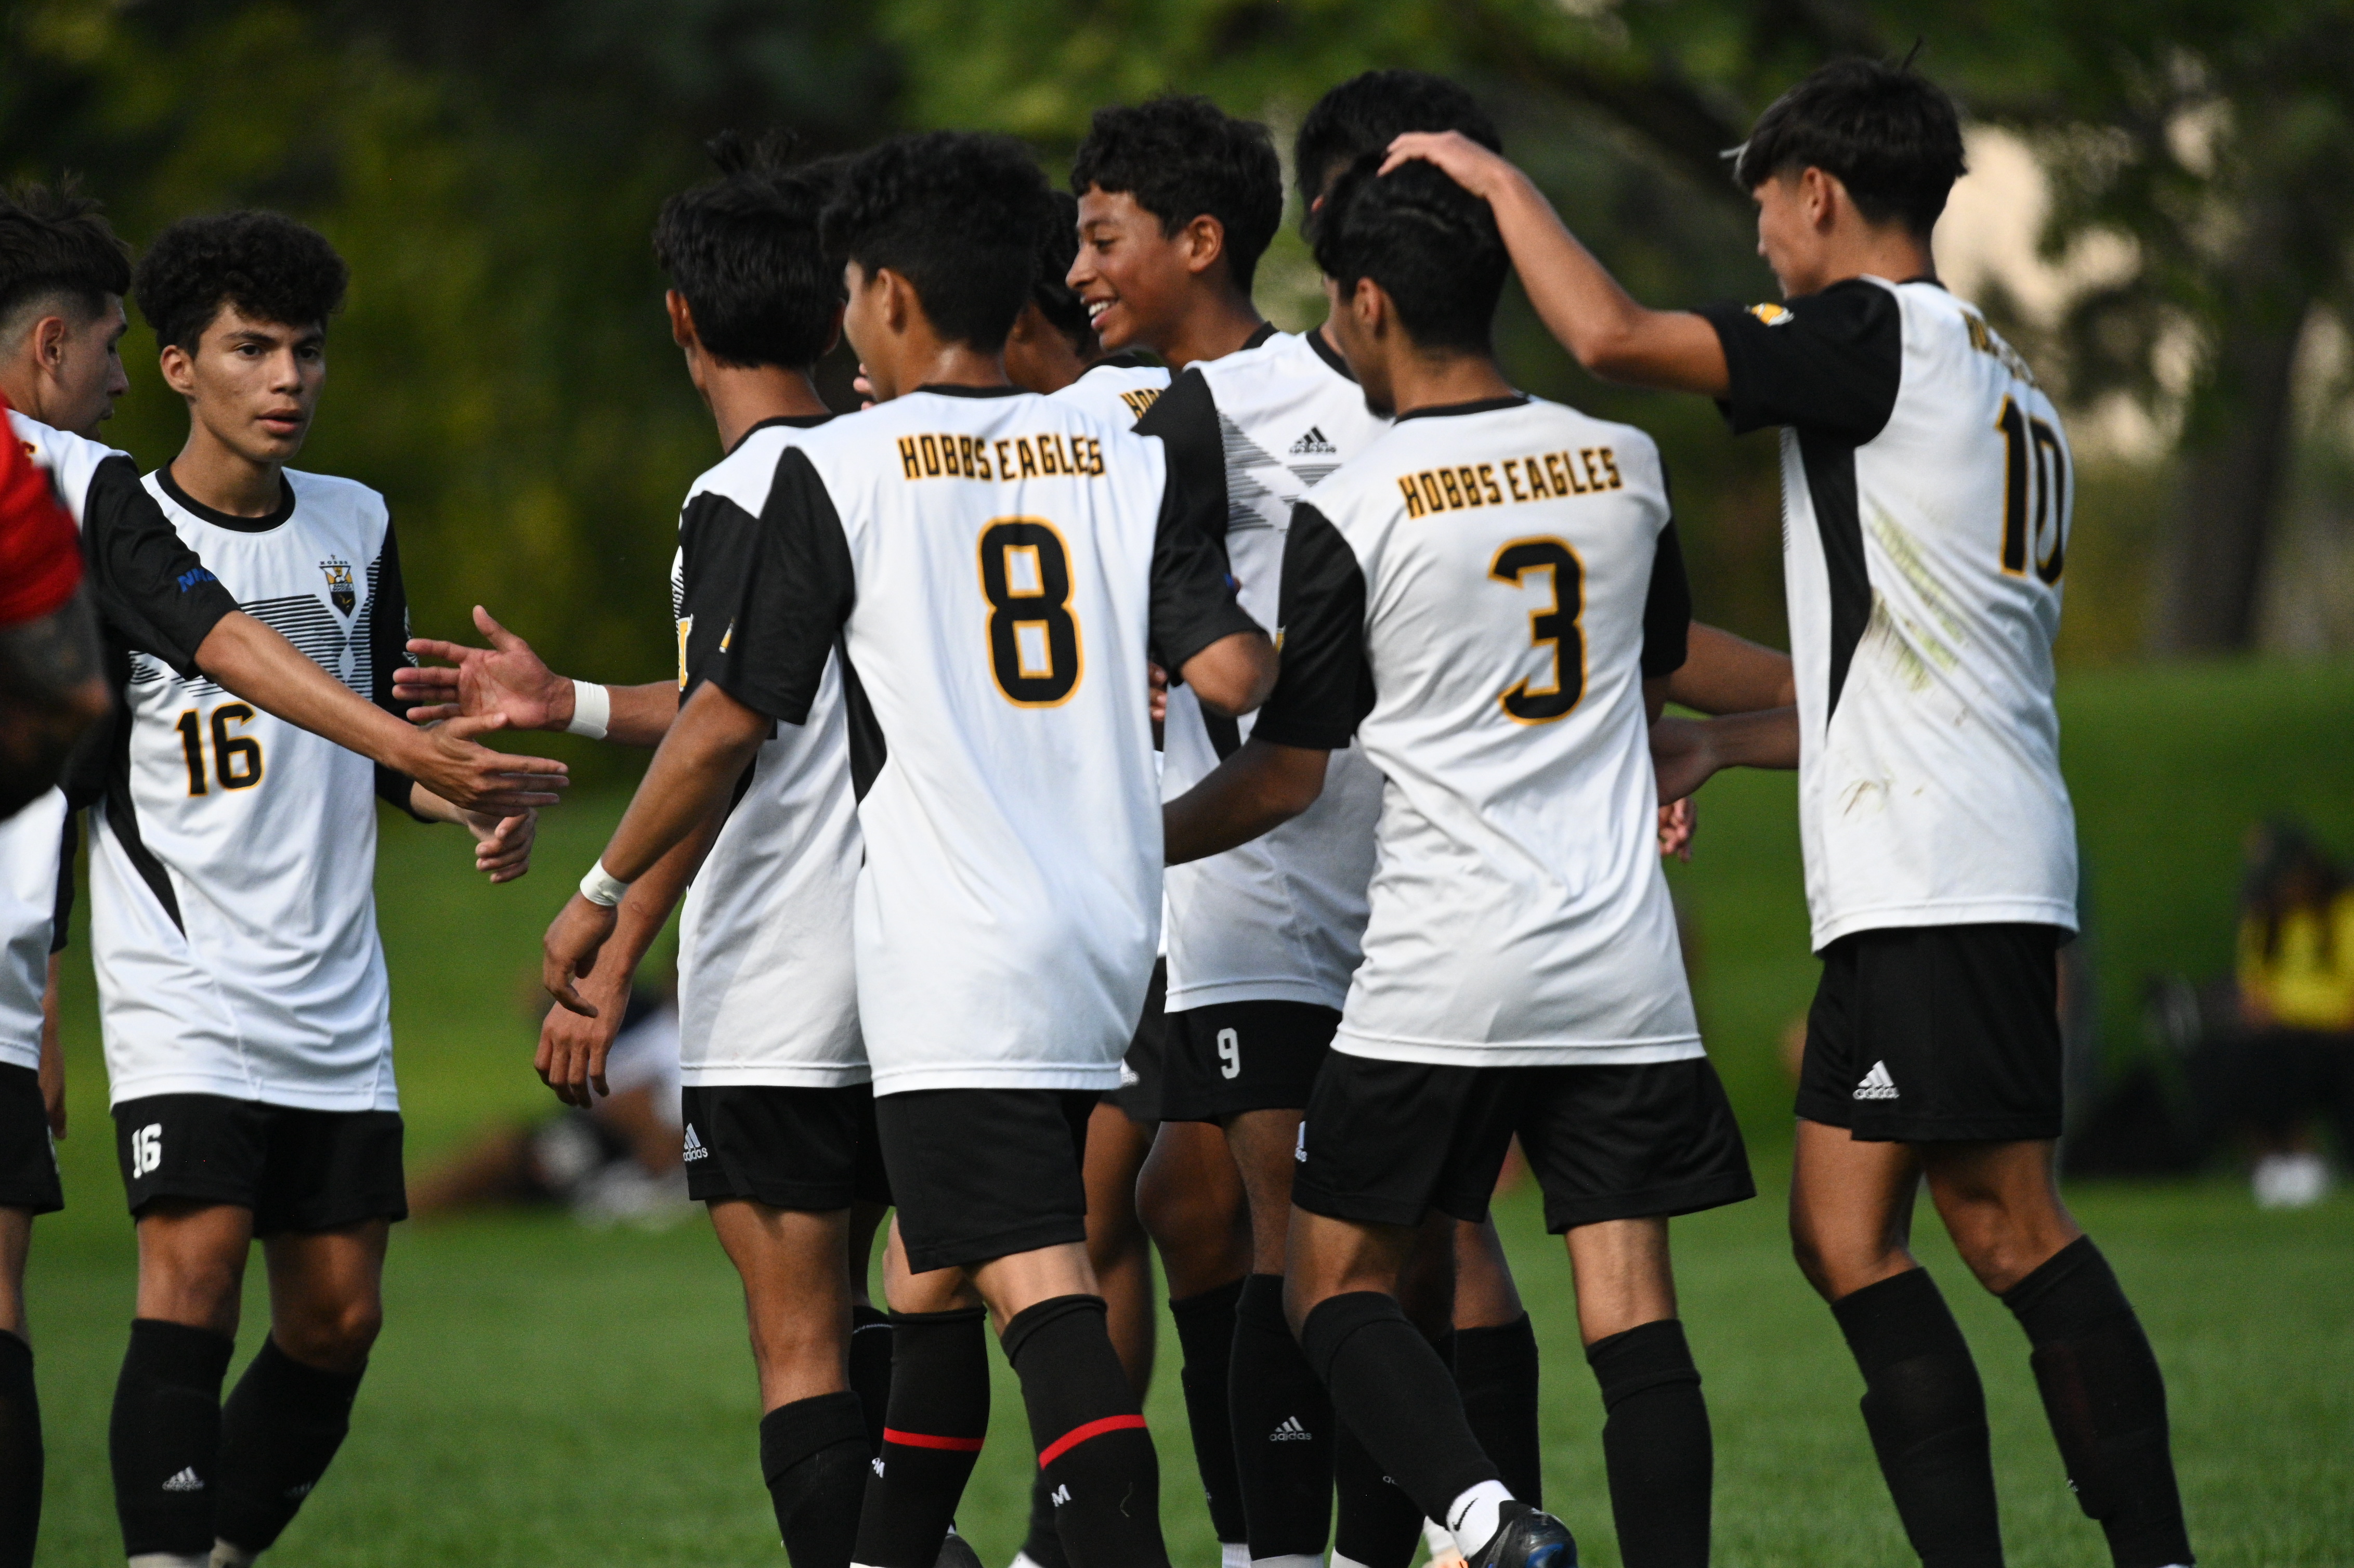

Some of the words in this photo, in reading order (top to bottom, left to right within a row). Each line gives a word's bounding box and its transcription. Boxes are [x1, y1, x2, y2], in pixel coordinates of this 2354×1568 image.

[897, 433, 992, 481] HOBBS
[994, 433, 1106, 481] EAGLES
[1397, 463, 1504, 520] HOBBS
[1502, 446, 1623, 503] EAGLES
[1995, 394, 2064, 586] 10
[977, 515, 1083, 708] 8
[1488, 535, 1587, 725] 3
[176, 702, 263, 797] 16
[1217, 1027, 1240, 1079] 9
[132, 1123, 162, 1179] 16
[683, 1147, 708, 1162] adidas
[1269, 1431, 1312, 1441] adidas
